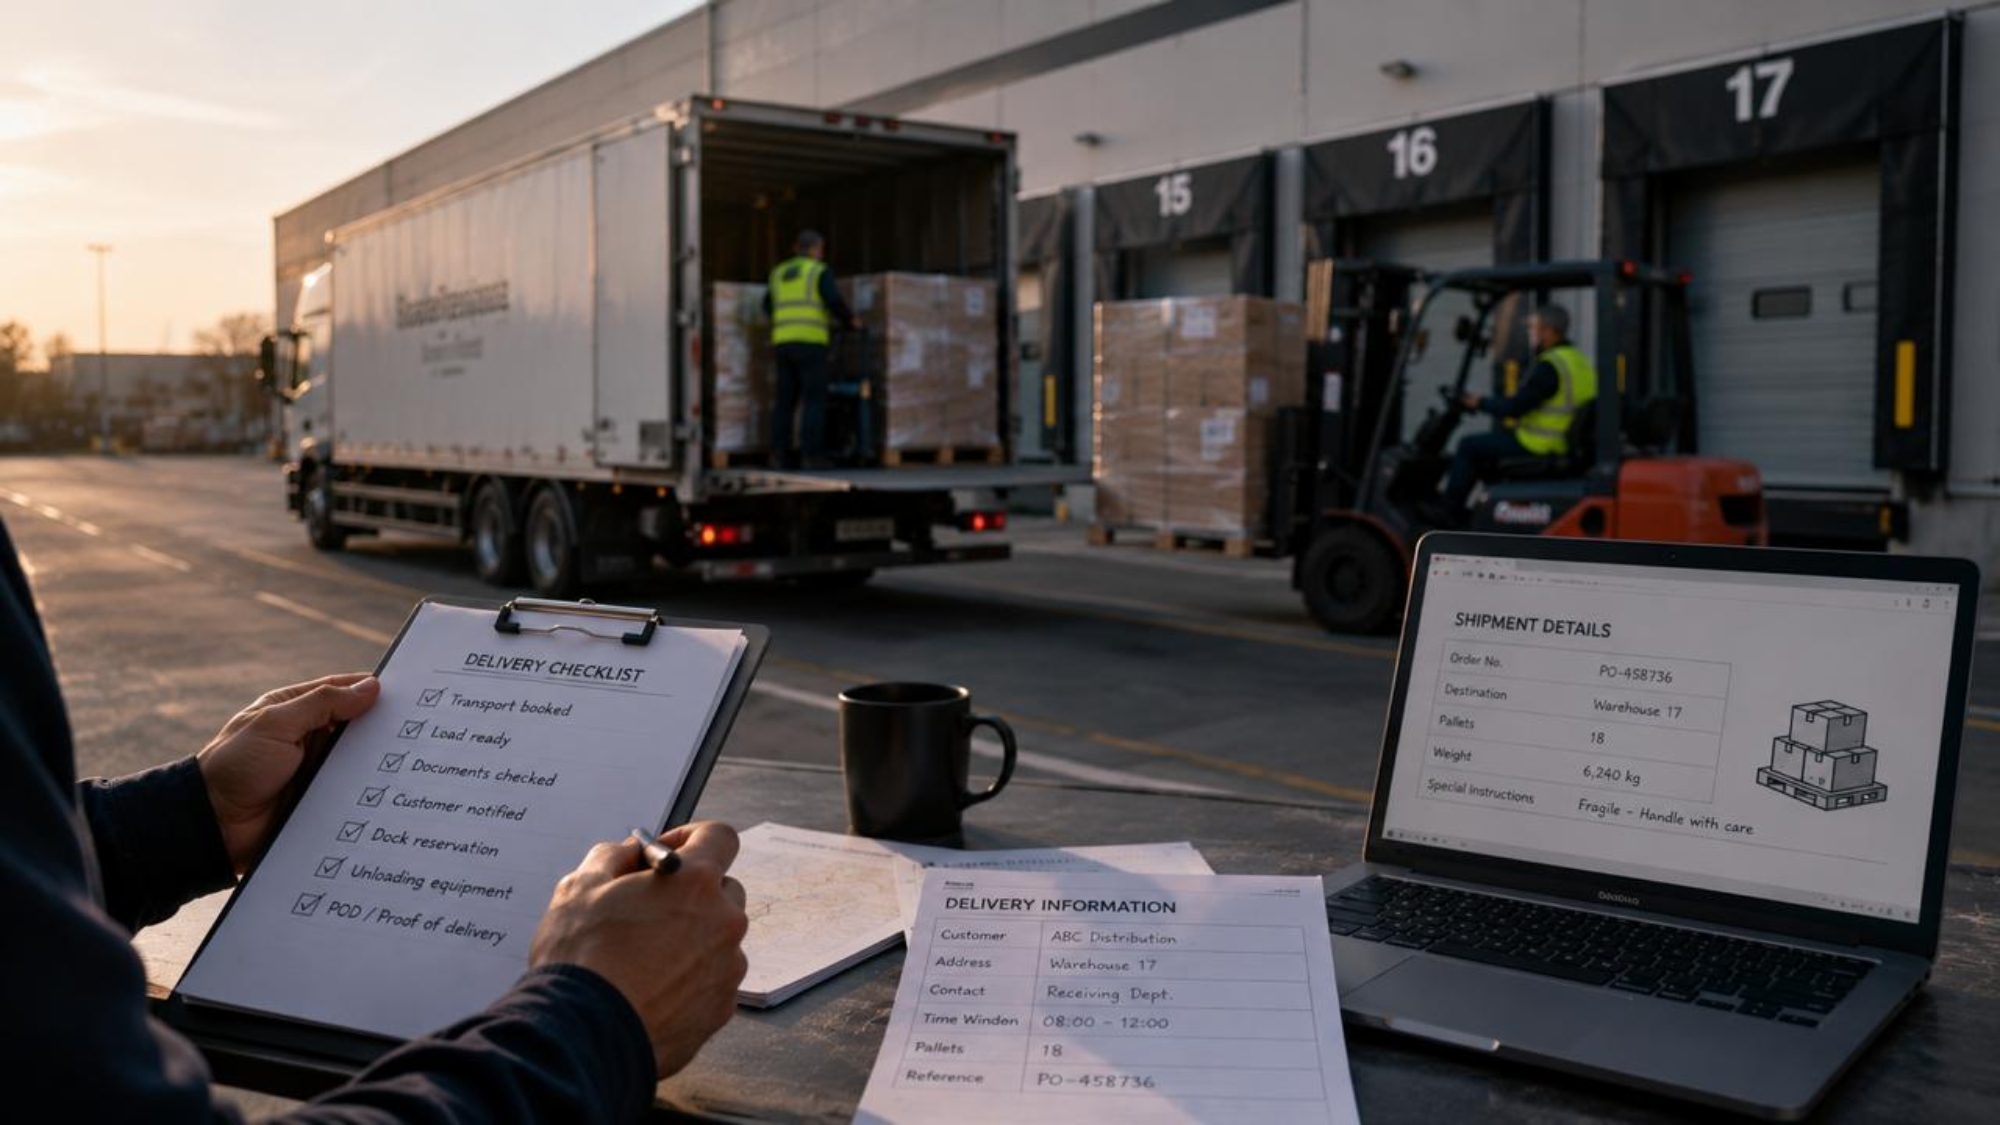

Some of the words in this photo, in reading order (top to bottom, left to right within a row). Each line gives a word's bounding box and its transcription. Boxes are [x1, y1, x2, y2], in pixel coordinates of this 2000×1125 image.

[1726, 58, 1794, 121] 17
[1387, 126, 1438, 178] 16
[1154, 174, 1192, 217] 15
[1455, 612, 1538, 632] SHIPMENT
[1543, 619, 1612, 638] DETAILS
[464, 652, 548, 673] DELIVERY
[548, 661, 645, 683] CHECKLIST
[1450, 652, 1481, 668] Order
[1484, 656, 1503, 668] No.
[1599, 664, 1673, 684] PO-458736
[1445, 683, 1507, 700] Destination
[450, 693, 515, 714] Transport
[520, 699, 572, 717] booked
[1593, 698, 1661, 717] Warehouse
[1667, 705, 1682, 717] 17
[1438, 714, 1475, 730] Pallets
[431, 726, 465, 741] Load
[470, 732, 511, 748] ready
[1590, 732, 1604, 744] 18
[1433, 746, 1472, 764] Weight
[411, 758, 490, 780] Documents
[495, 767, 558, 787] checked
[1583, 765, 1622, 783] 6,240
[1624, 771, 1641, 787] kg
[1427, 778, 1466, 797] Special
[392, 794, 462, 814] Customer
[467, 801, 526, 821] notified
[1578, 799, 1621, 819] Fragile
[1640, 807, 1684, 826] Handle
[1690, 814, 1719, 831] with
[1724, 822, 1753, 835] care
[371, 828, 408, 847] Dock
[412, 837, 499, 857] reservation
[350, 865, 424, 890] Unloading
[430, 875, 513, 900] equipment
[945, 897, 1035, 912] DELIVERY
[1041, 898, 1176, 914] INFORMATION
[326, 901, 361, 919] POD
[377, 909, 421, 932] Proof
[423, 916, 441, 933] of
[444, 919, 507, 946] delivery
[941, 929, 1006, 941] Customer
[1050, 931, 1083, 943] ABC
[1089, 931, 1177, 945] Distribution
[935, 956, 992, 969] Address
[1050, 958, 1130, 972] Warehouse
[1138, 959, 1157, 971] 17
[929, 984, 986, 997] Contact
[1047, 987, 1120, 1003] Receiving
[1130, 988, 1174, 1002] Dept.
[924, 1013, 958, 1025] Time
[1043, 1016, 1095, 1029] 08:00
[1121, 1017, 1169, 1030] 12:00
[914, 1041, 964, 1054] Pallets
[1043, 1044, 1063, 1058] 18
[906, 1069, 984, 1083] Reference
[1037, 1072, 1155, 1089] PO-458736
